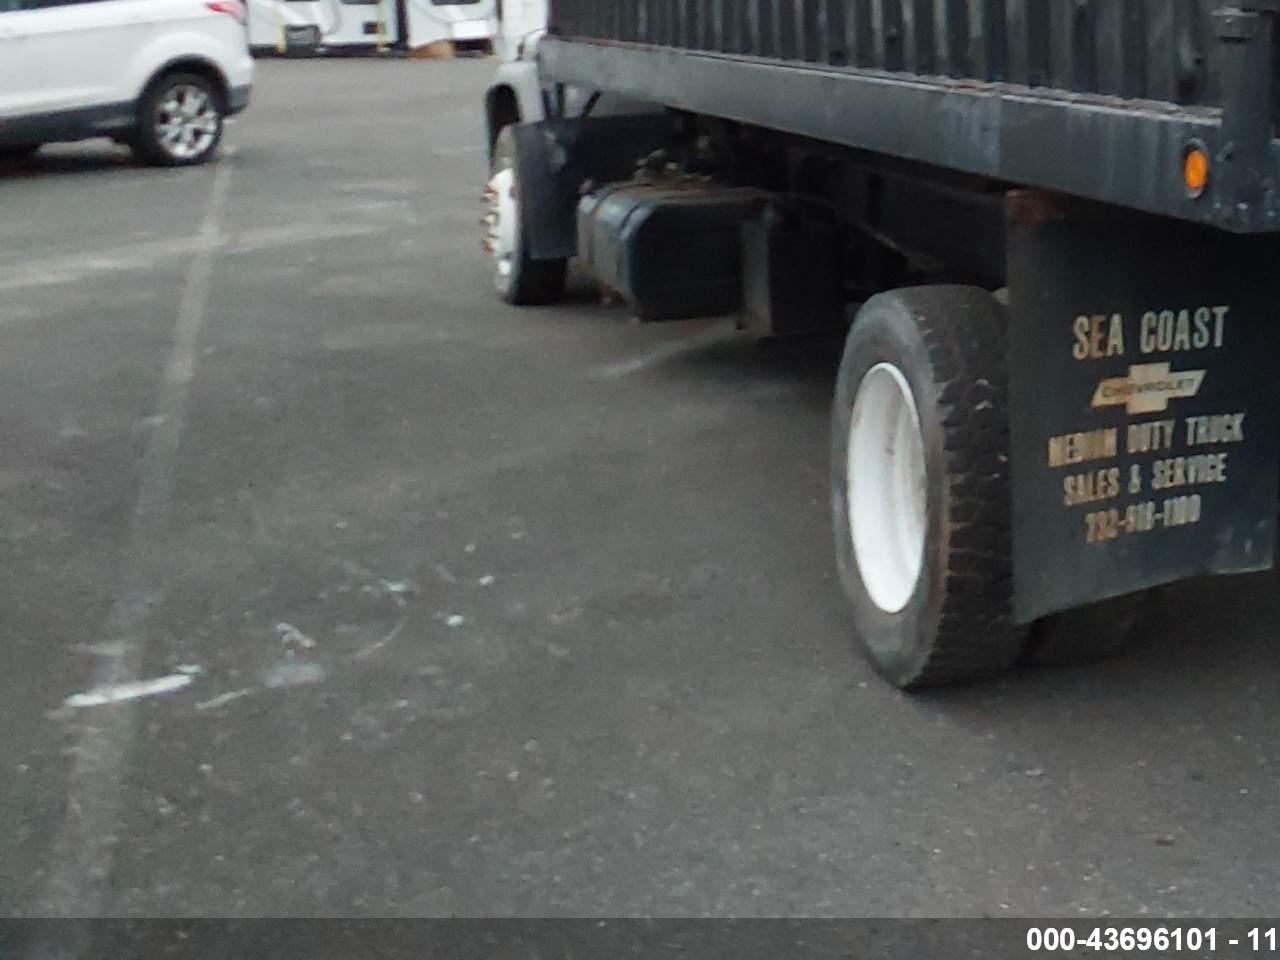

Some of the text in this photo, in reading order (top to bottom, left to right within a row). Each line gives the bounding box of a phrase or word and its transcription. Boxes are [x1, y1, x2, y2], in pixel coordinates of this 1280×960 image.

[1072, 306, 1230, 361] SEA COAST
[1127, 419, 1175, 454] DUTY
[1185, 413, 1245, 446] TRUCK
[1064, 453, 1228, 507] SALES & SERVICE
